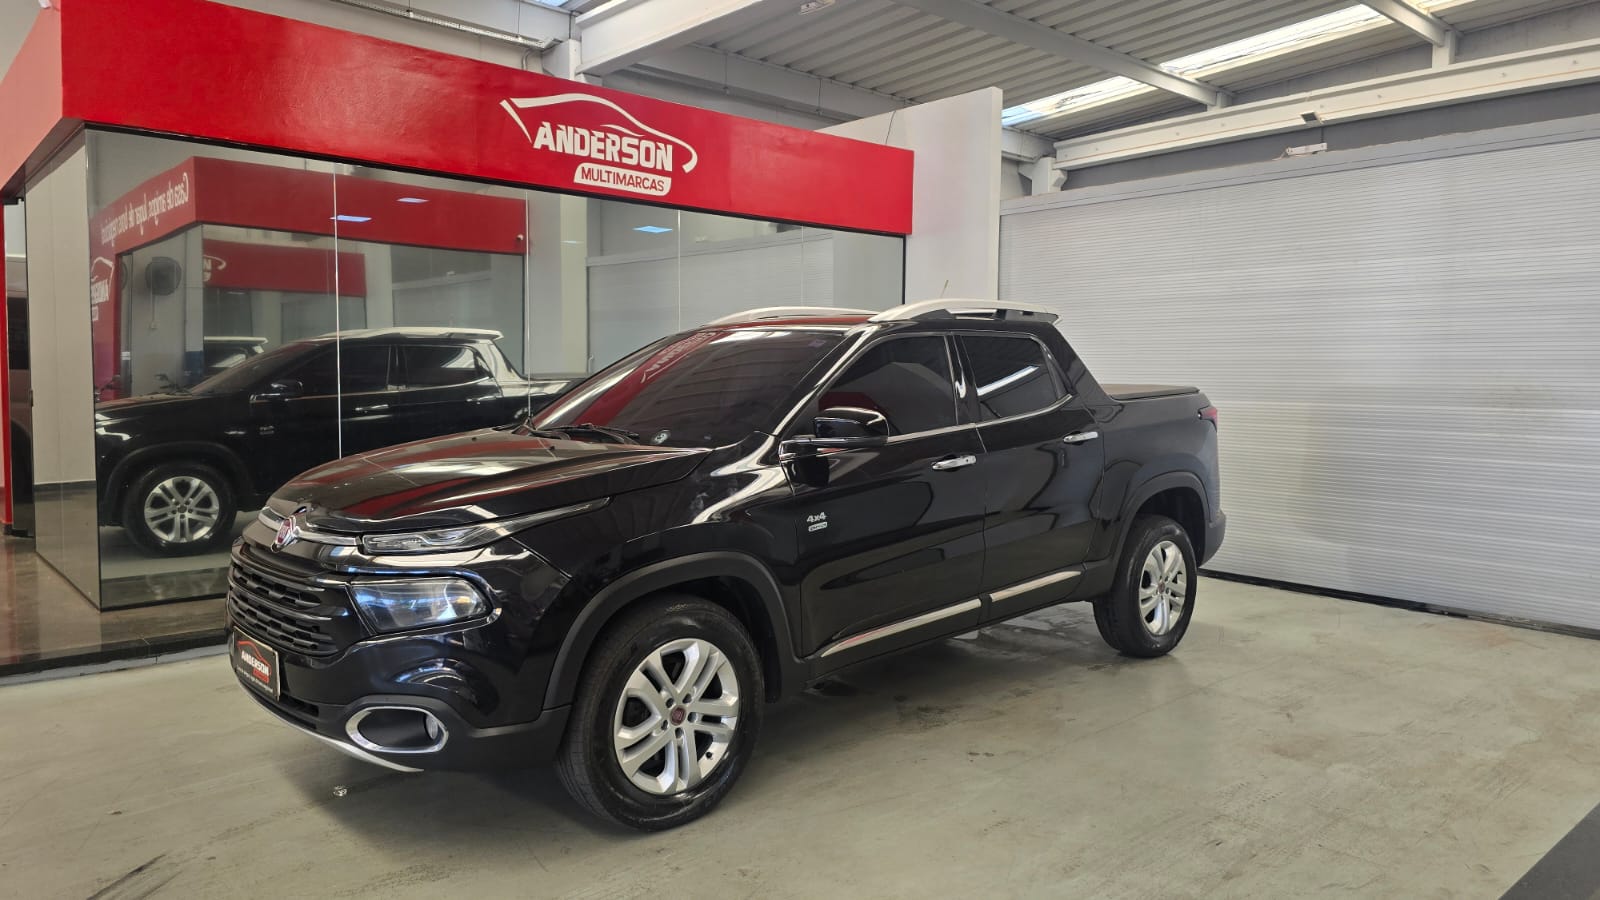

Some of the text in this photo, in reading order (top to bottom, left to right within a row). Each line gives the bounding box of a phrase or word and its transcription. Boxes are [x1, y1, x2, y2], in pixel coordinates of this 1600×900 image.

[533, 121, 672, 171] ANDERSON
[581, 166, 664, 191] MULTIMARCAS
[807, 512, 827, 522] 4x4
